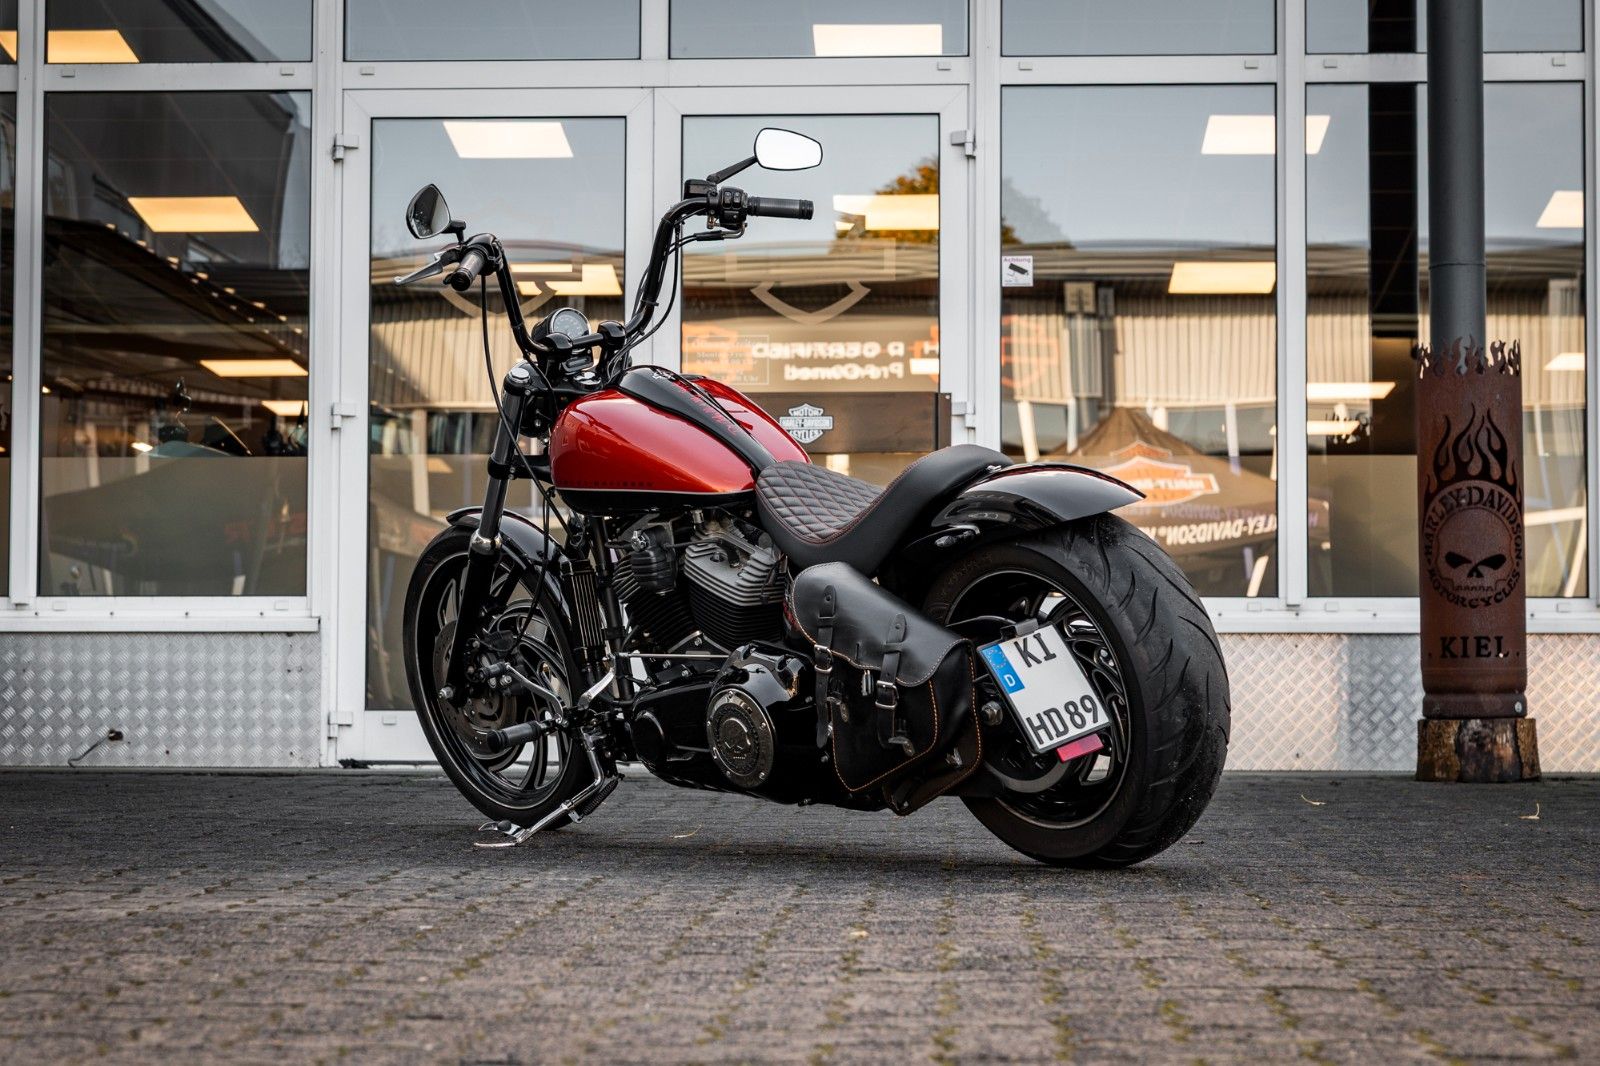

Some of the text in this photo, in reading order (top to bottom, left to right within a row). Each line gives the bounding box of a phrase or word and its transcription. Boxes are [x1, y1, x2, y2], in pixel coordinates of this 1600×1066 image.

[793, 407, 820, 416] MOTOR
[1014, 633, 1056, 668] KI
[1440, 636, 1509, 659] KIEL
[1004, 674, 1016, 687] D
